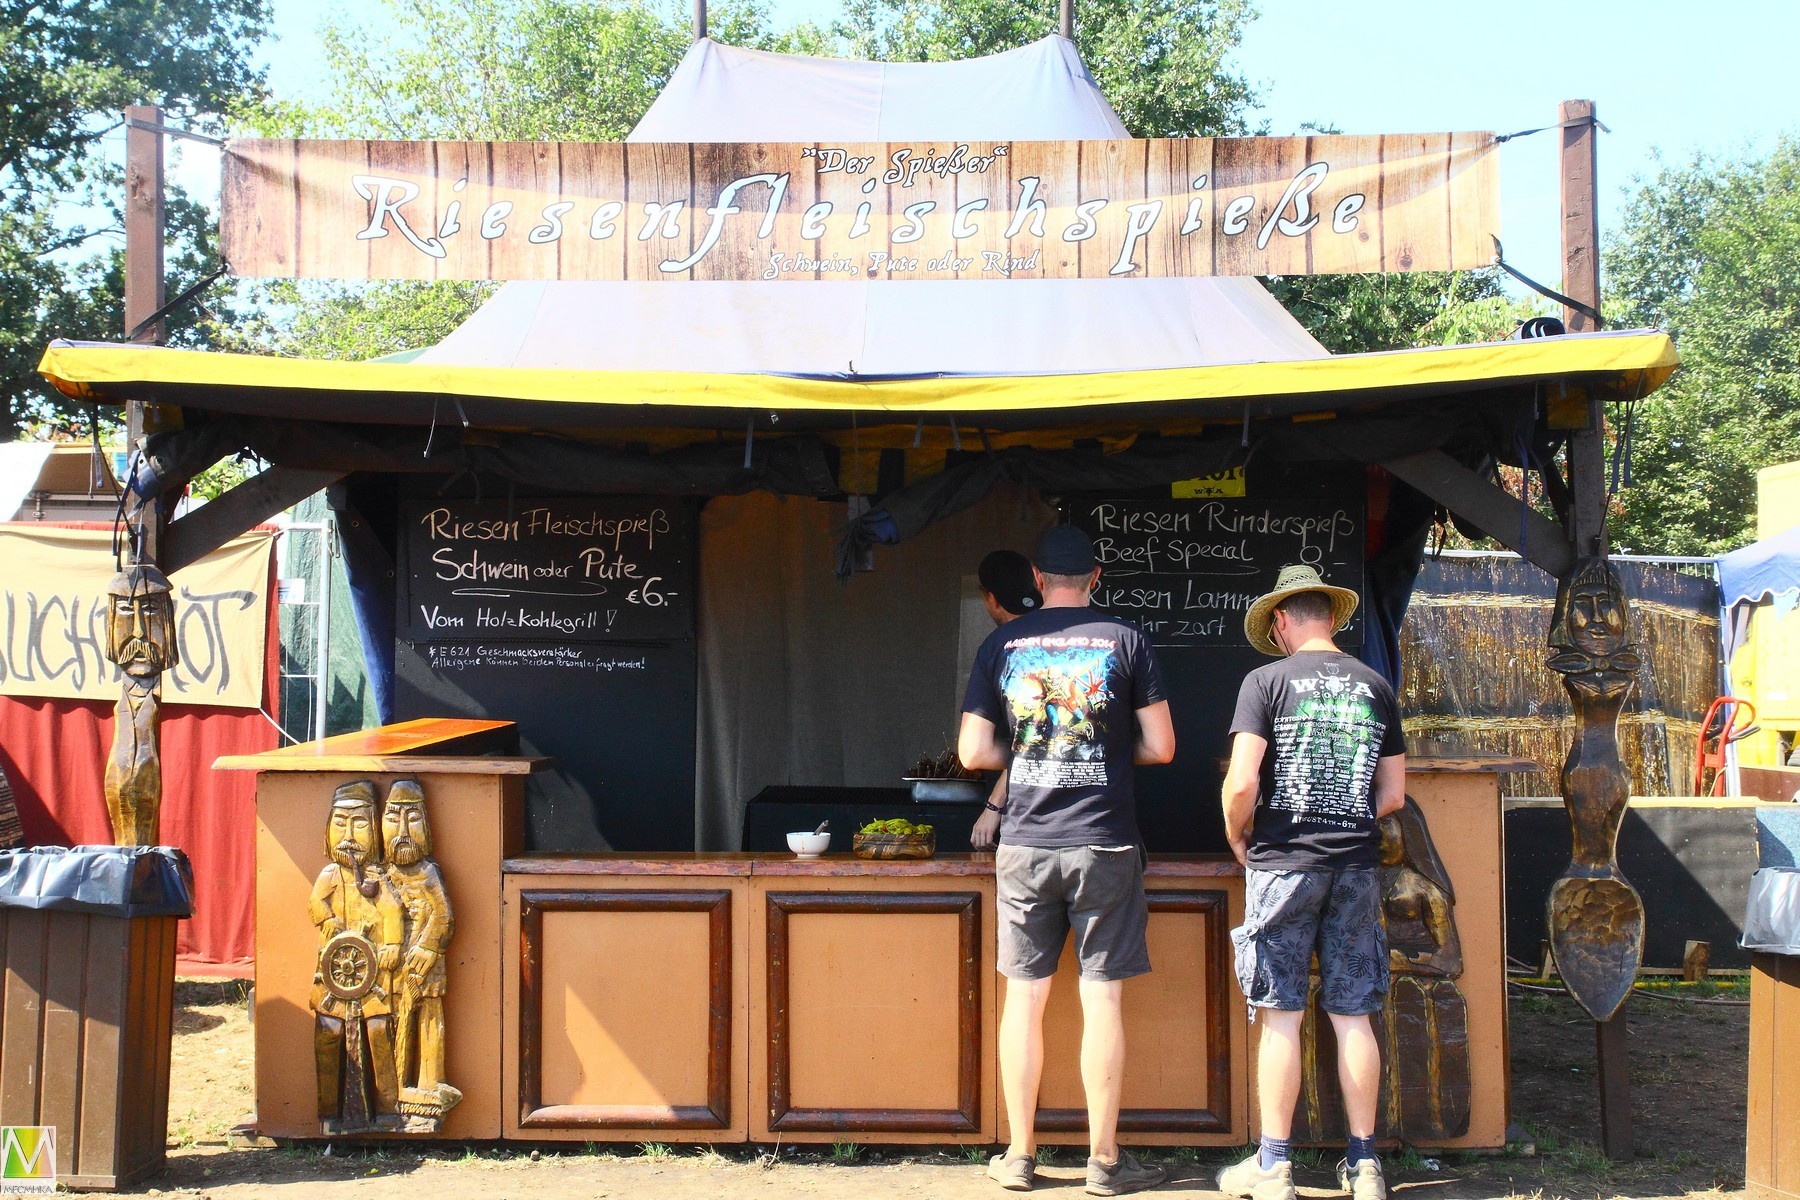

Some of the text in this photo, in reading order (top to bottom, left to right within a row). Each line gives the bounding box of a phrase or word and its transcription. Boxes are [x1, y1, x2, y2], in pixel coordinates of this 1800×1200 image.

[351, 162, 1367, 276] Riesenfleischspieße
[763, 249, 1041, 280] Schwein, Pute oder Rind
[421, 508, 669, 551] Riesen Fleischspieß
[1090, 501, 1354, 552] Riesen Rinderspieß
[432, 547, 643, 582] Schwein oder Pute
[1093, 536, 1253, 572] Beef Special
[420, 605, 464, 629] Vom
[1171, 616, 1226, 636] zart
[1041, 636, 1090, 648] ENGLAND
[431, 657, 480, 671] Allergene
